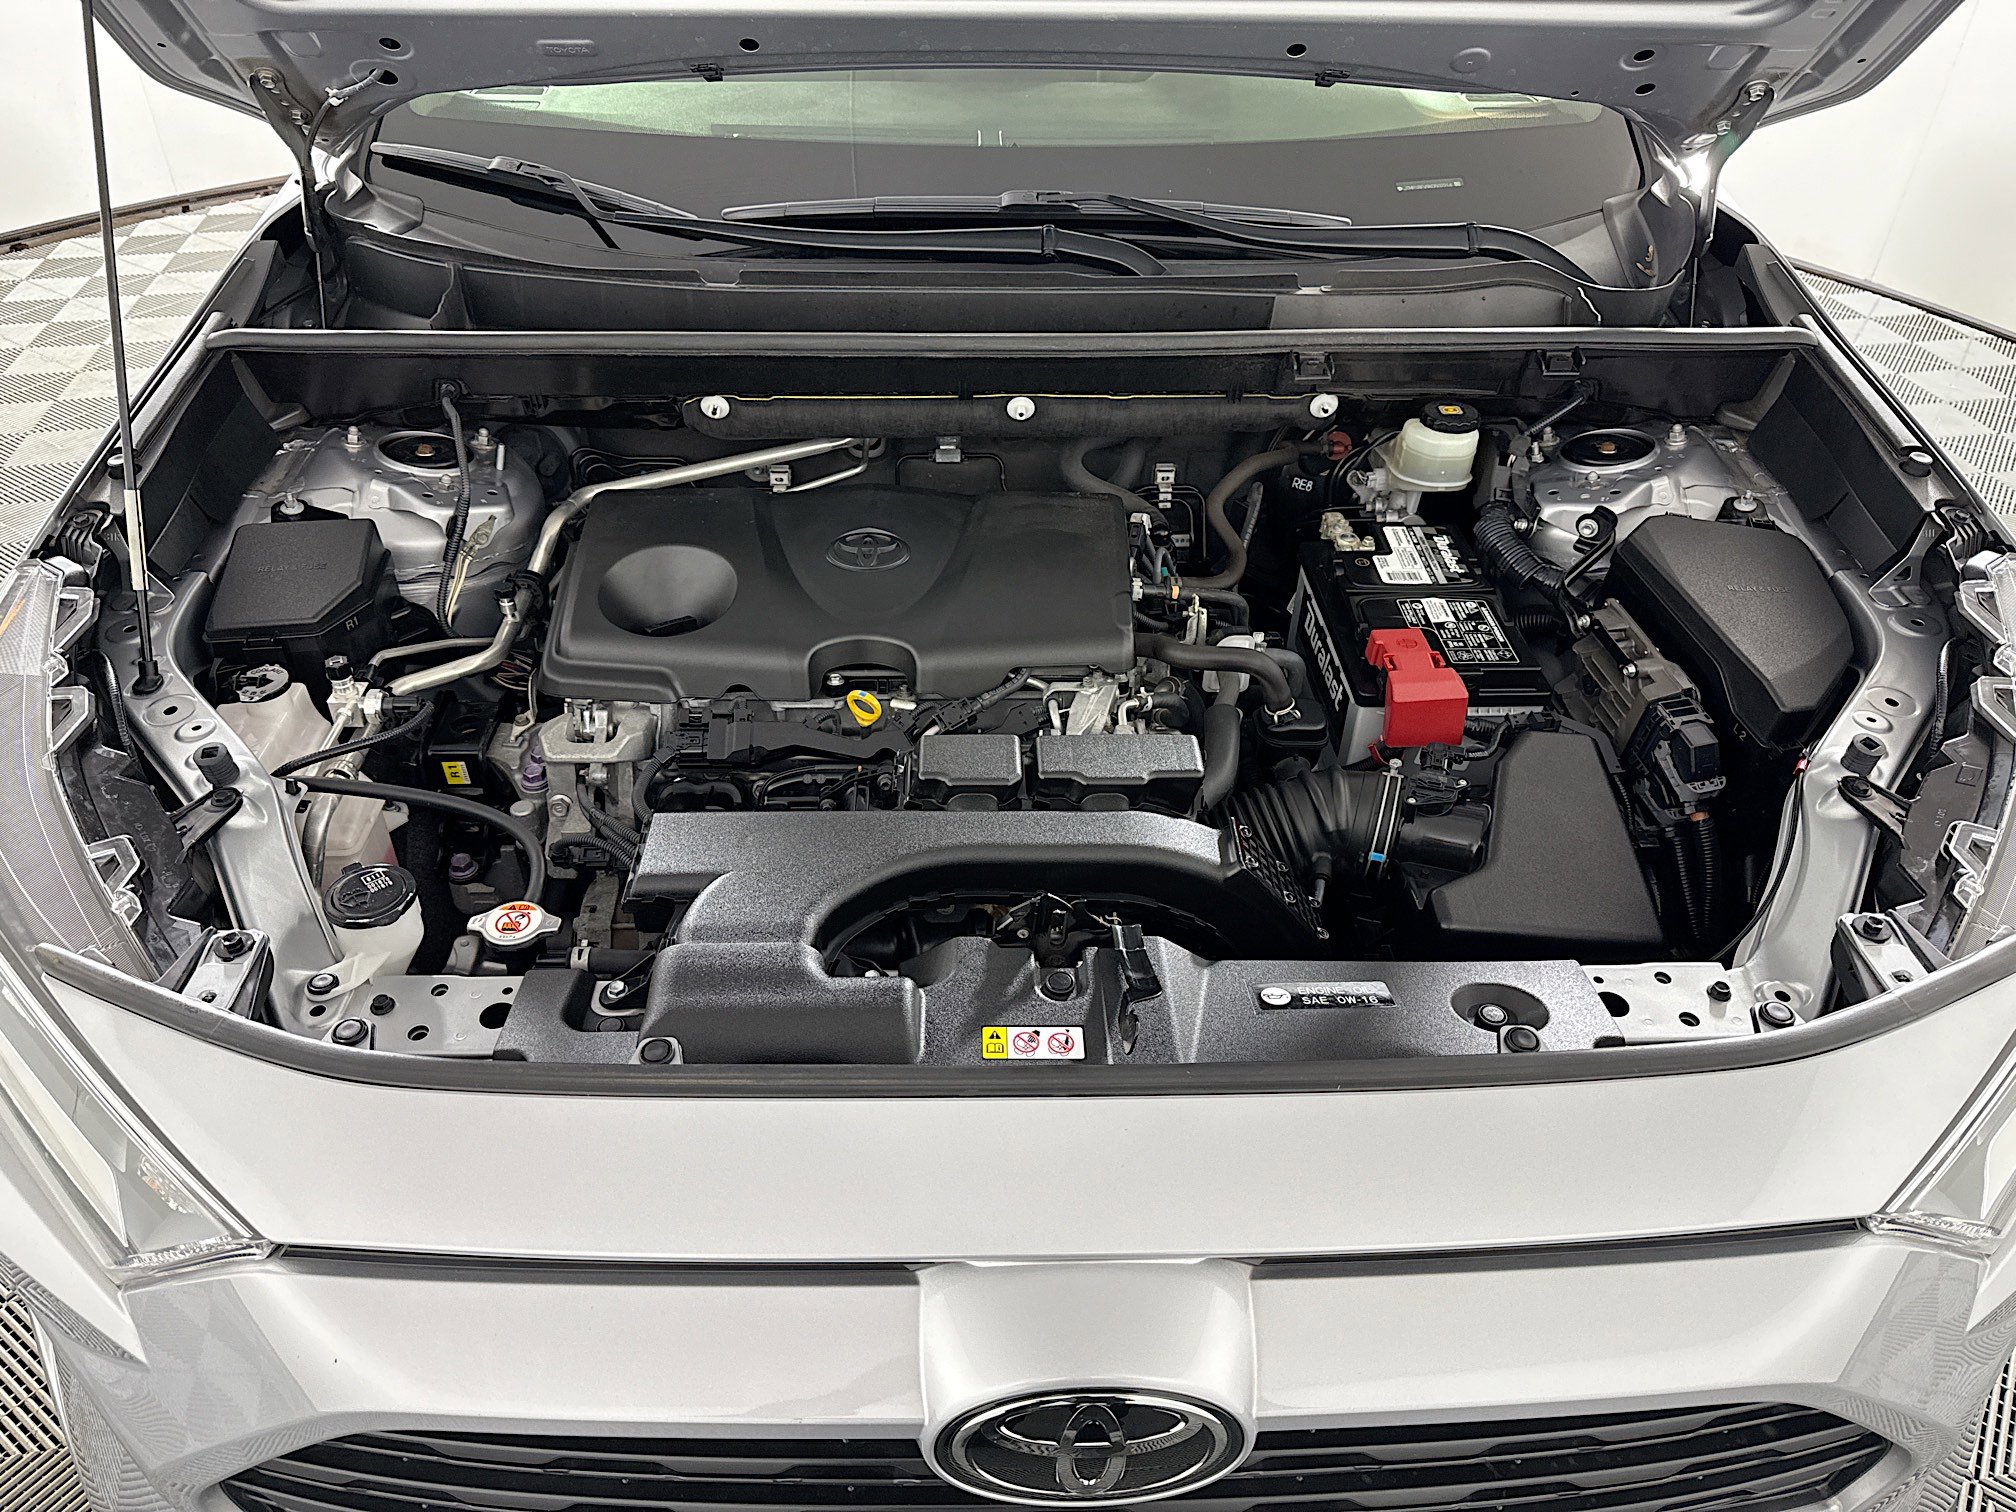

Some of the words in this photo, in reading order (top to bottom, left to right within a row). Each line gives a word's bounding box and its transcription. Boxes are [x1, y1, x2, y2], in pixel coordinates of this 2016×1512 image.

[545, 46, 590, 54] TOYOTA
[1291, 476, 1313, 492] RE8
[1432, 534, 1466, 574] Duralast
[257, 565, 290, 573] RELAY
[345, 616, 359, 631] R1
[1304, 600, 1343, 712] Duralast
[448, 765, 461, 778] R1
[1296, 986, 1346, 995] ENGINE
[1352, 986, 1374, 995] OIL
[1302, 996, 1330, 1005] SAE
[1337, 995, 1379, 1005] 0W-16
